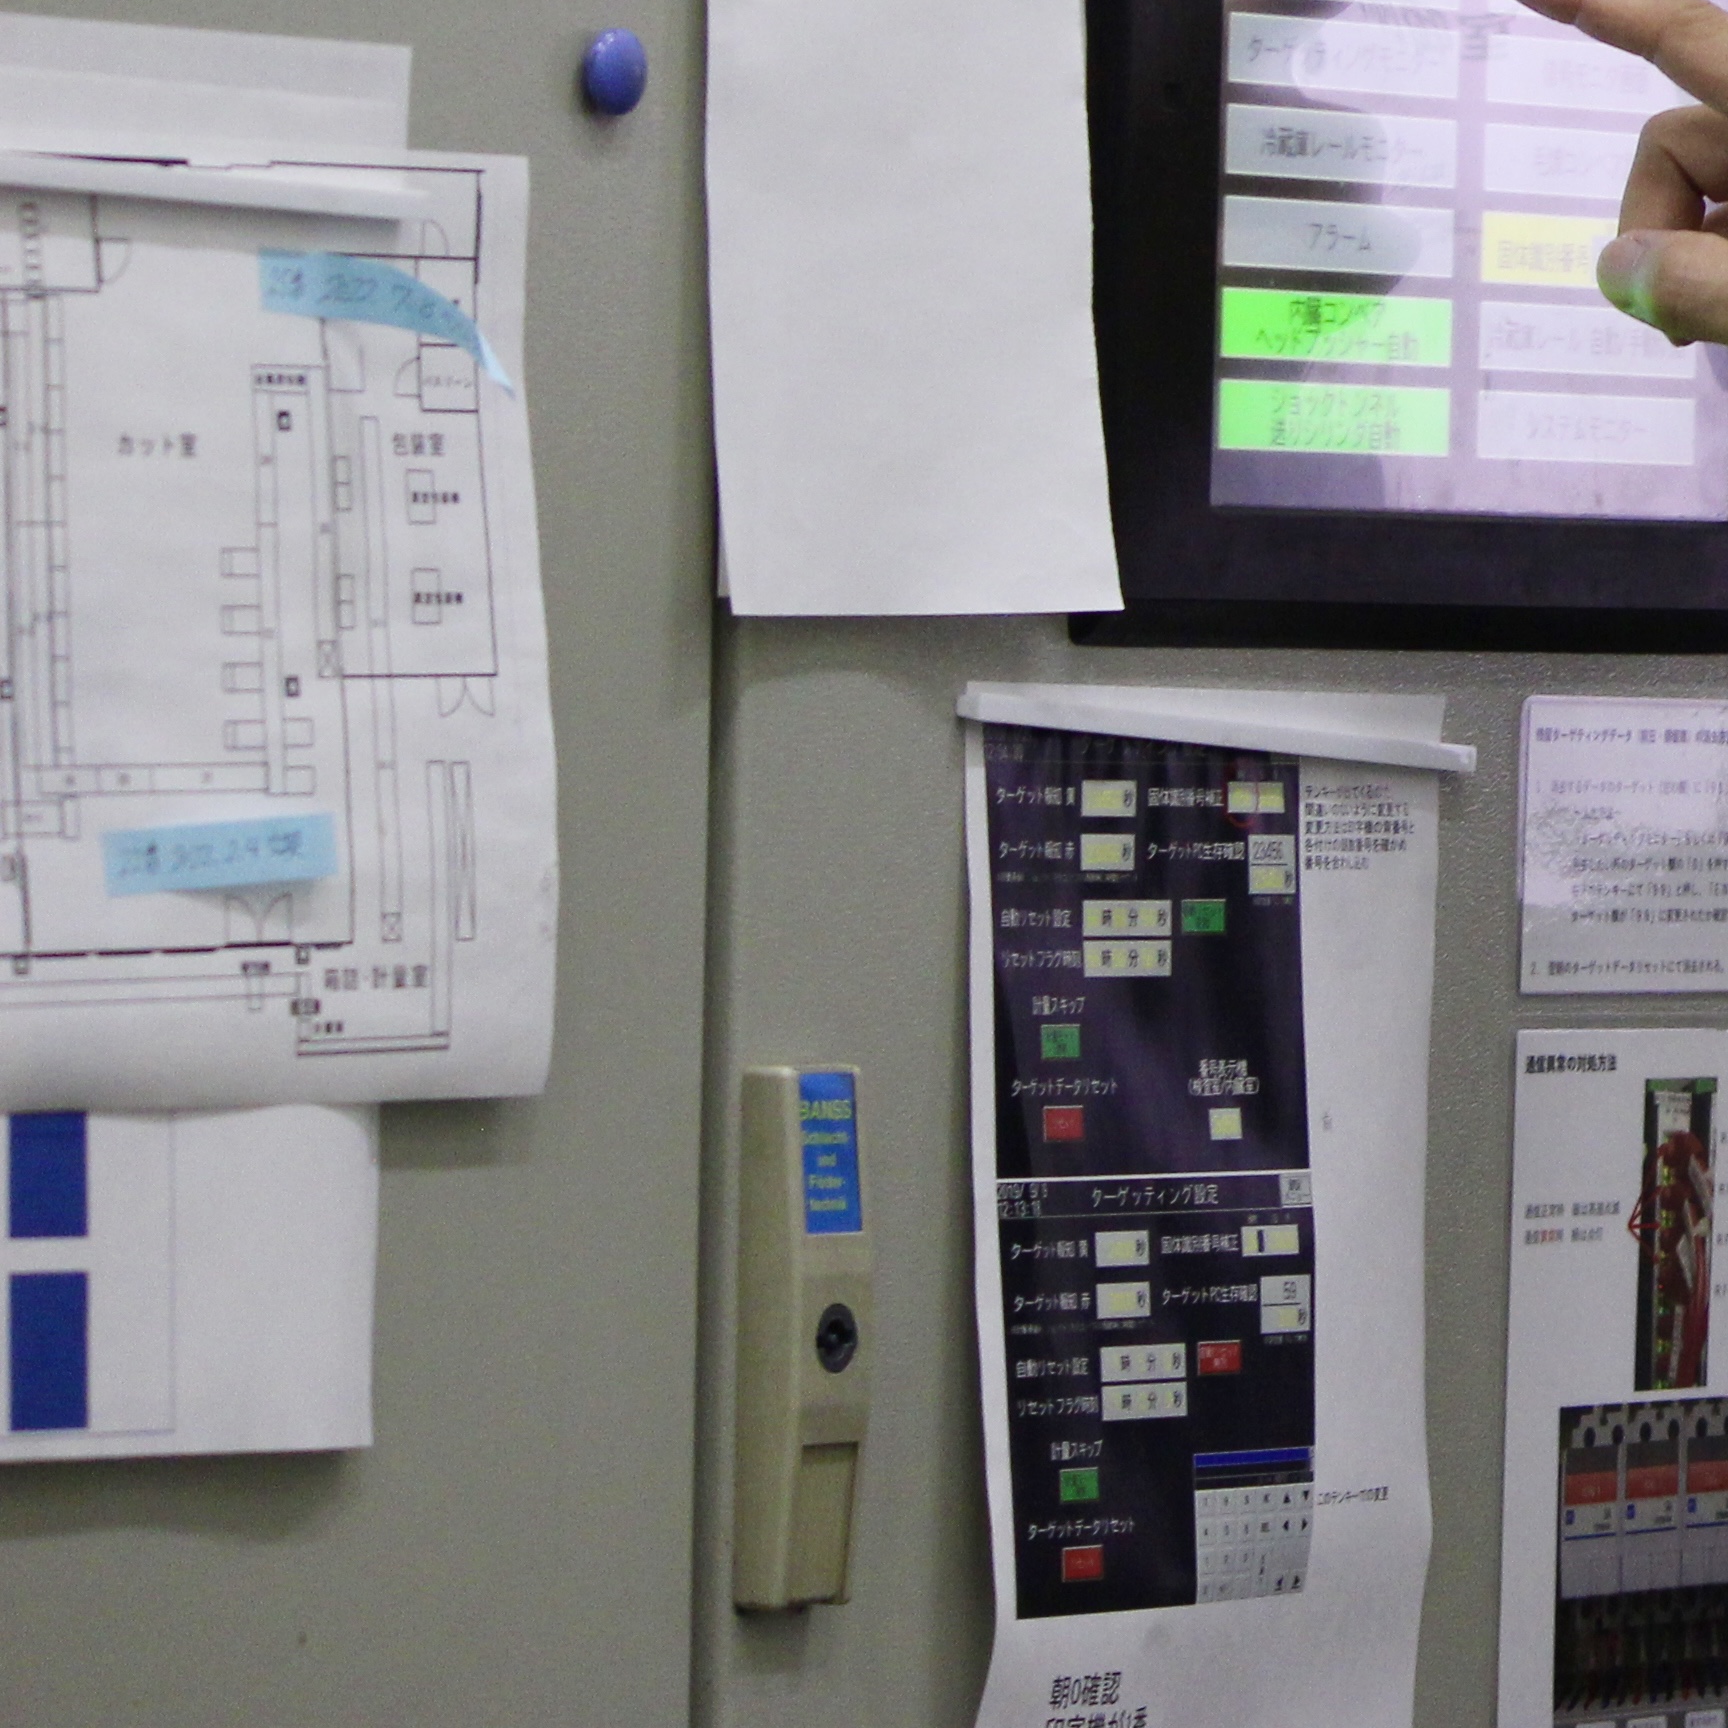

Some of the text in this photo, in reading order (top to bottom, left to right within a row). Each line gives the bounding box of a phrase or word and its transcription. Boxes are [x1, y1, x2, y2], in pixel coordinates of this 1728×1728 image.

[1092, 1184, 1219, 1208] ターゲッティング設定
